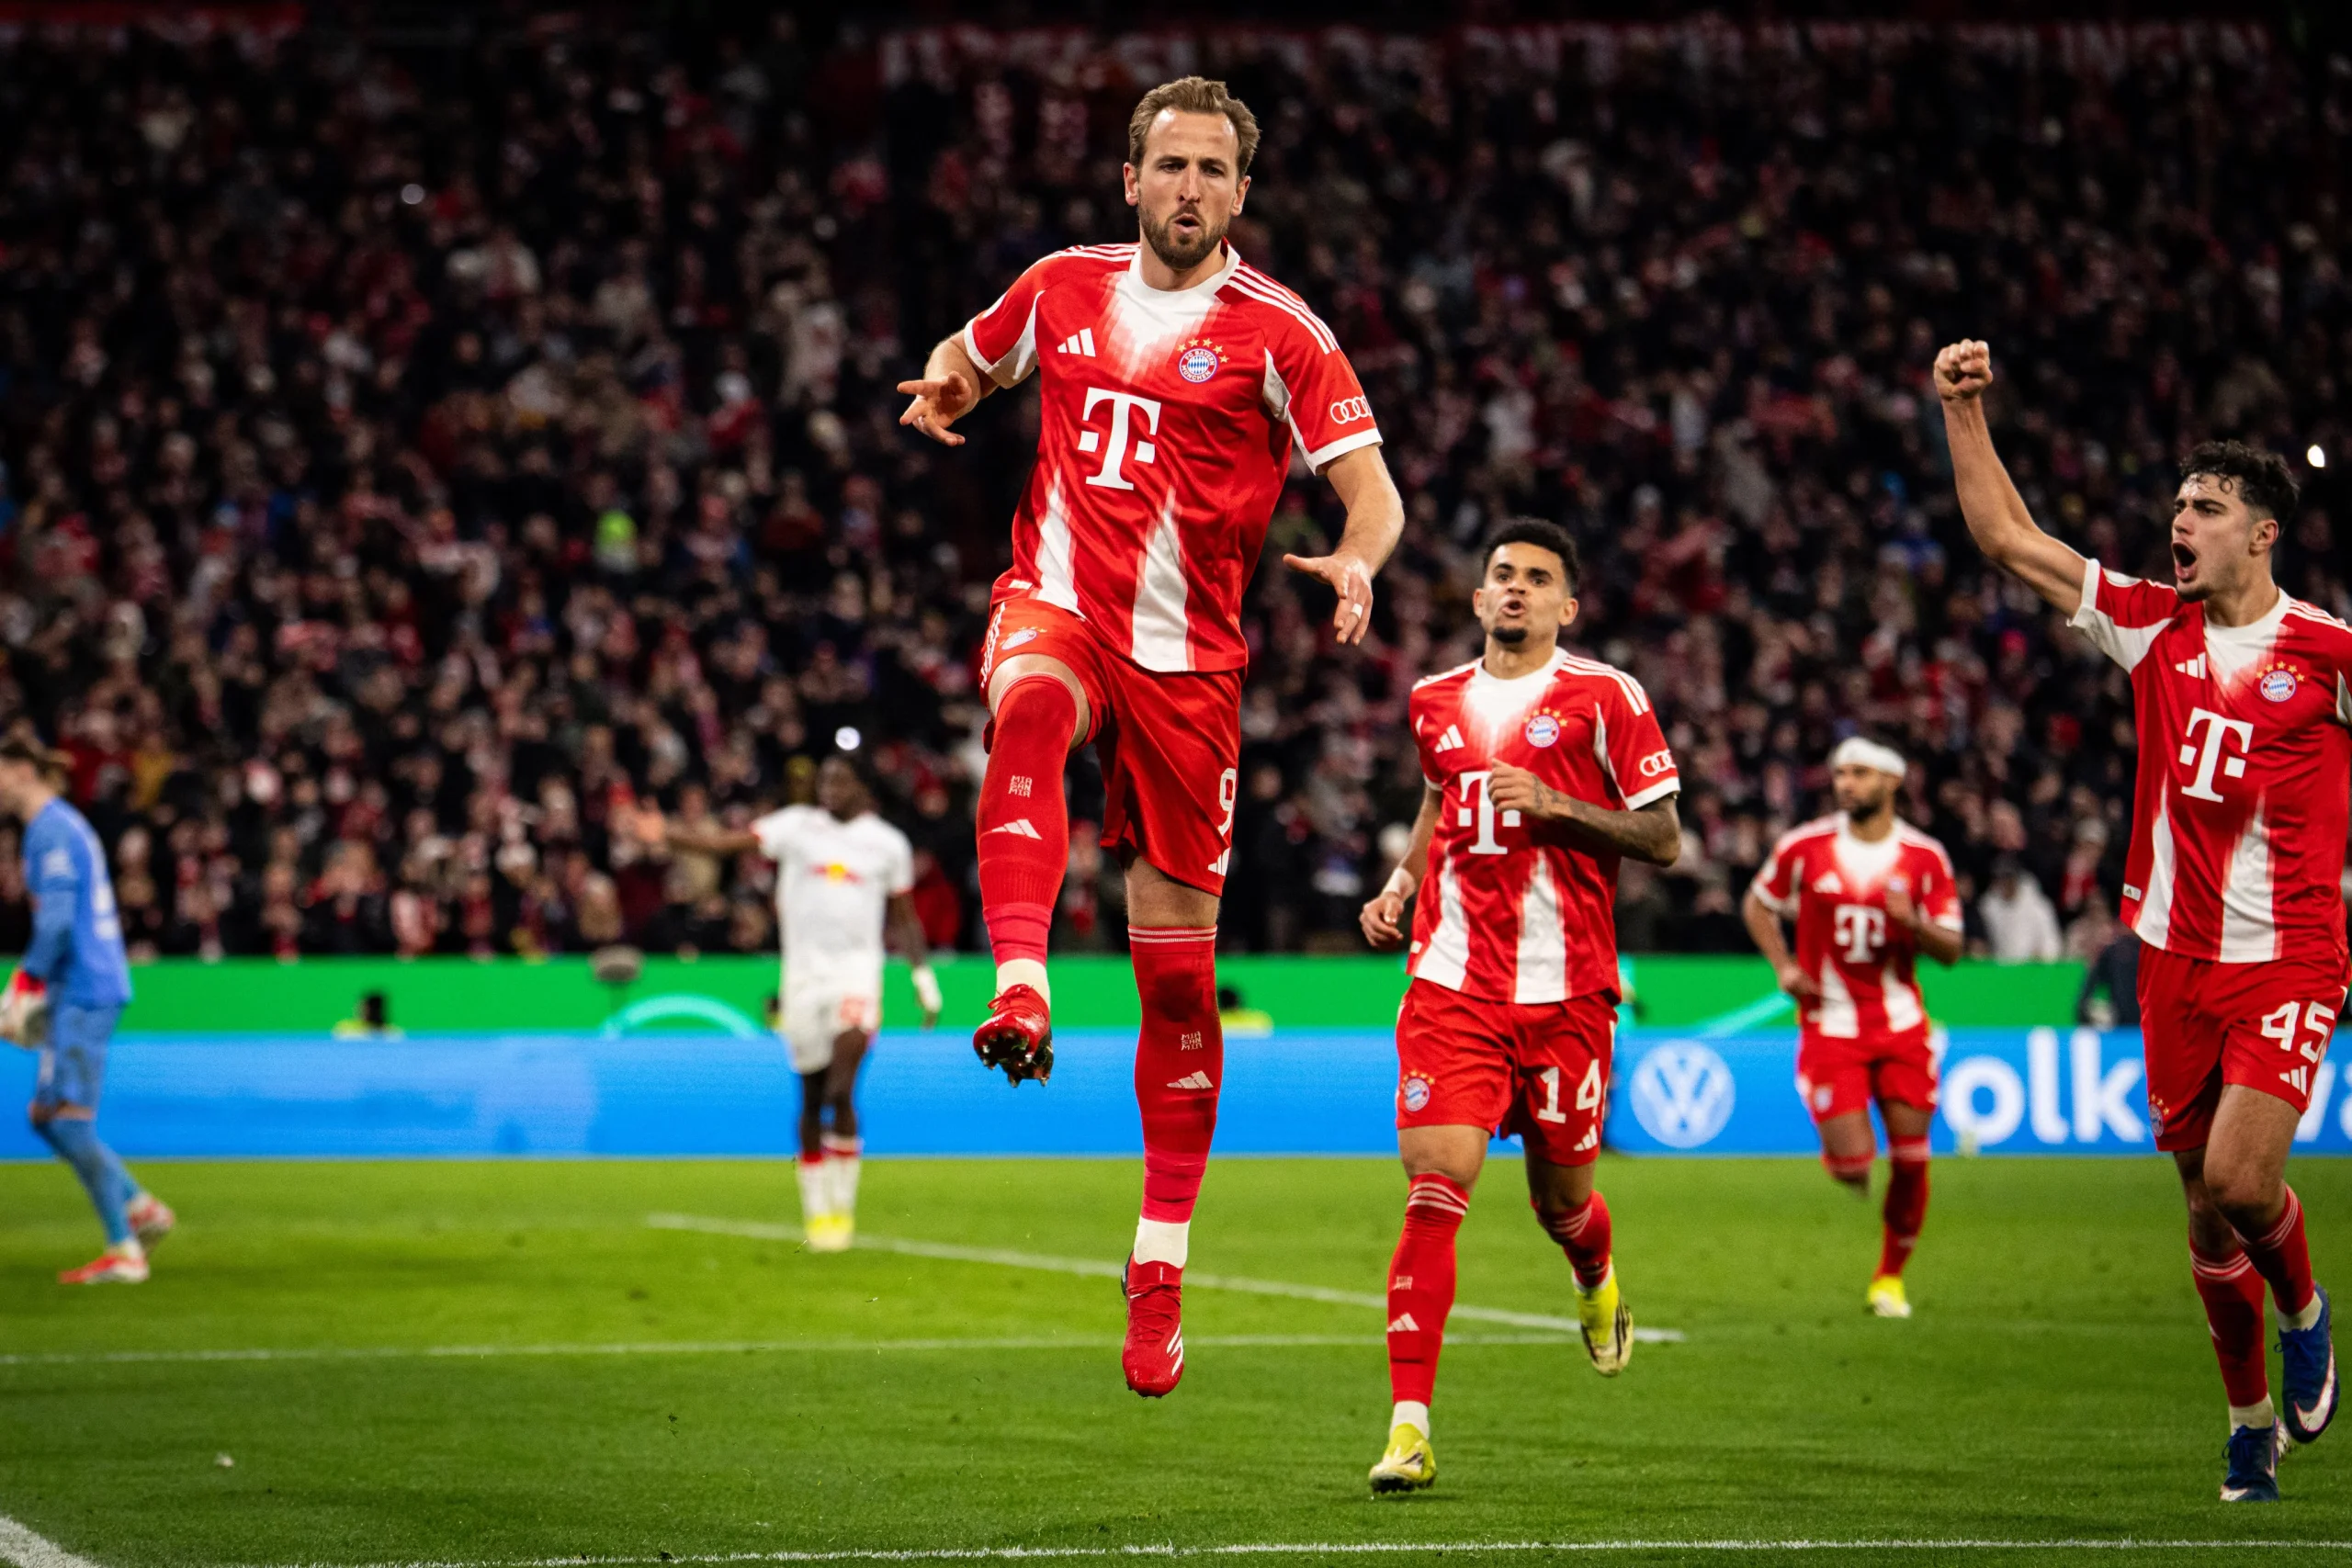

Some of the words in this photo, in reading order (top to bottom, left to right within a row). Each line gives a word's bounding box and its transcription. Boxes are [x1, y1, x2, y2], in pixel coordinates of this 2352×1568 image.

[1184, 352, 1194, 360] FC
[1194, 350, 1216, 366] BAYERN
[1078, 387, 1161, 491] T
[1010, 775, 1033, 785] MIA
[2179, 706, 2255, 804] T
[1218, 767, 1237, 837] 9
[1458, 771, 1521, 854] T
[1834, 903, 1886, 964] T
[2260, 1000, 2335, 1064] 45
[1537, 1058, 1601, 1123] 14
[1631, 1040, 1736, 1147] VW
